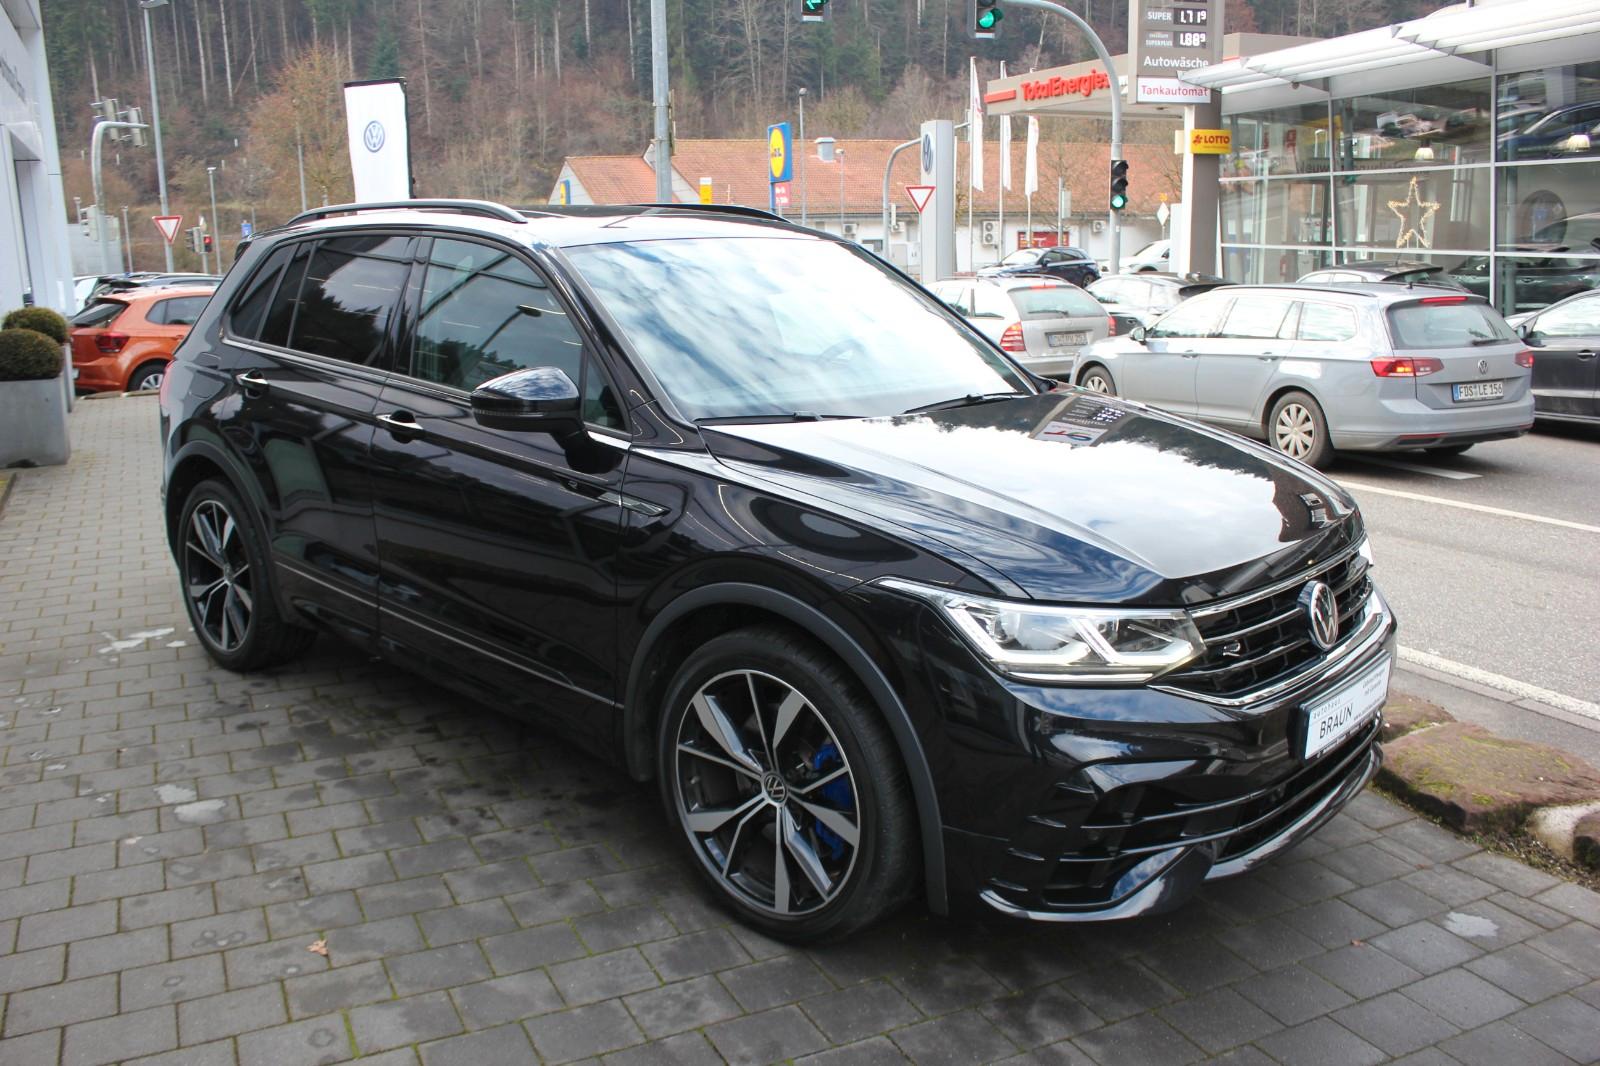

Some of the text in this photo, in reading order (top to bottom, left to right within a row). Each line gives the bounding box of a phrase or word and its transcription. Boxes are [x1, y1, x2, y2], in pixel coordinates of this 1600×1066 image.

[1147, 11, 1172, 20] SUPER
[1141, 85, 1208, 97] Tankautomat
[1203, 136, 1230, 144] LOTTO
[1458, 385, 1474, 397] FDS
[1478, 384, 1488, 396] LE
[1319, 702, 1353, 739] BRAUN
